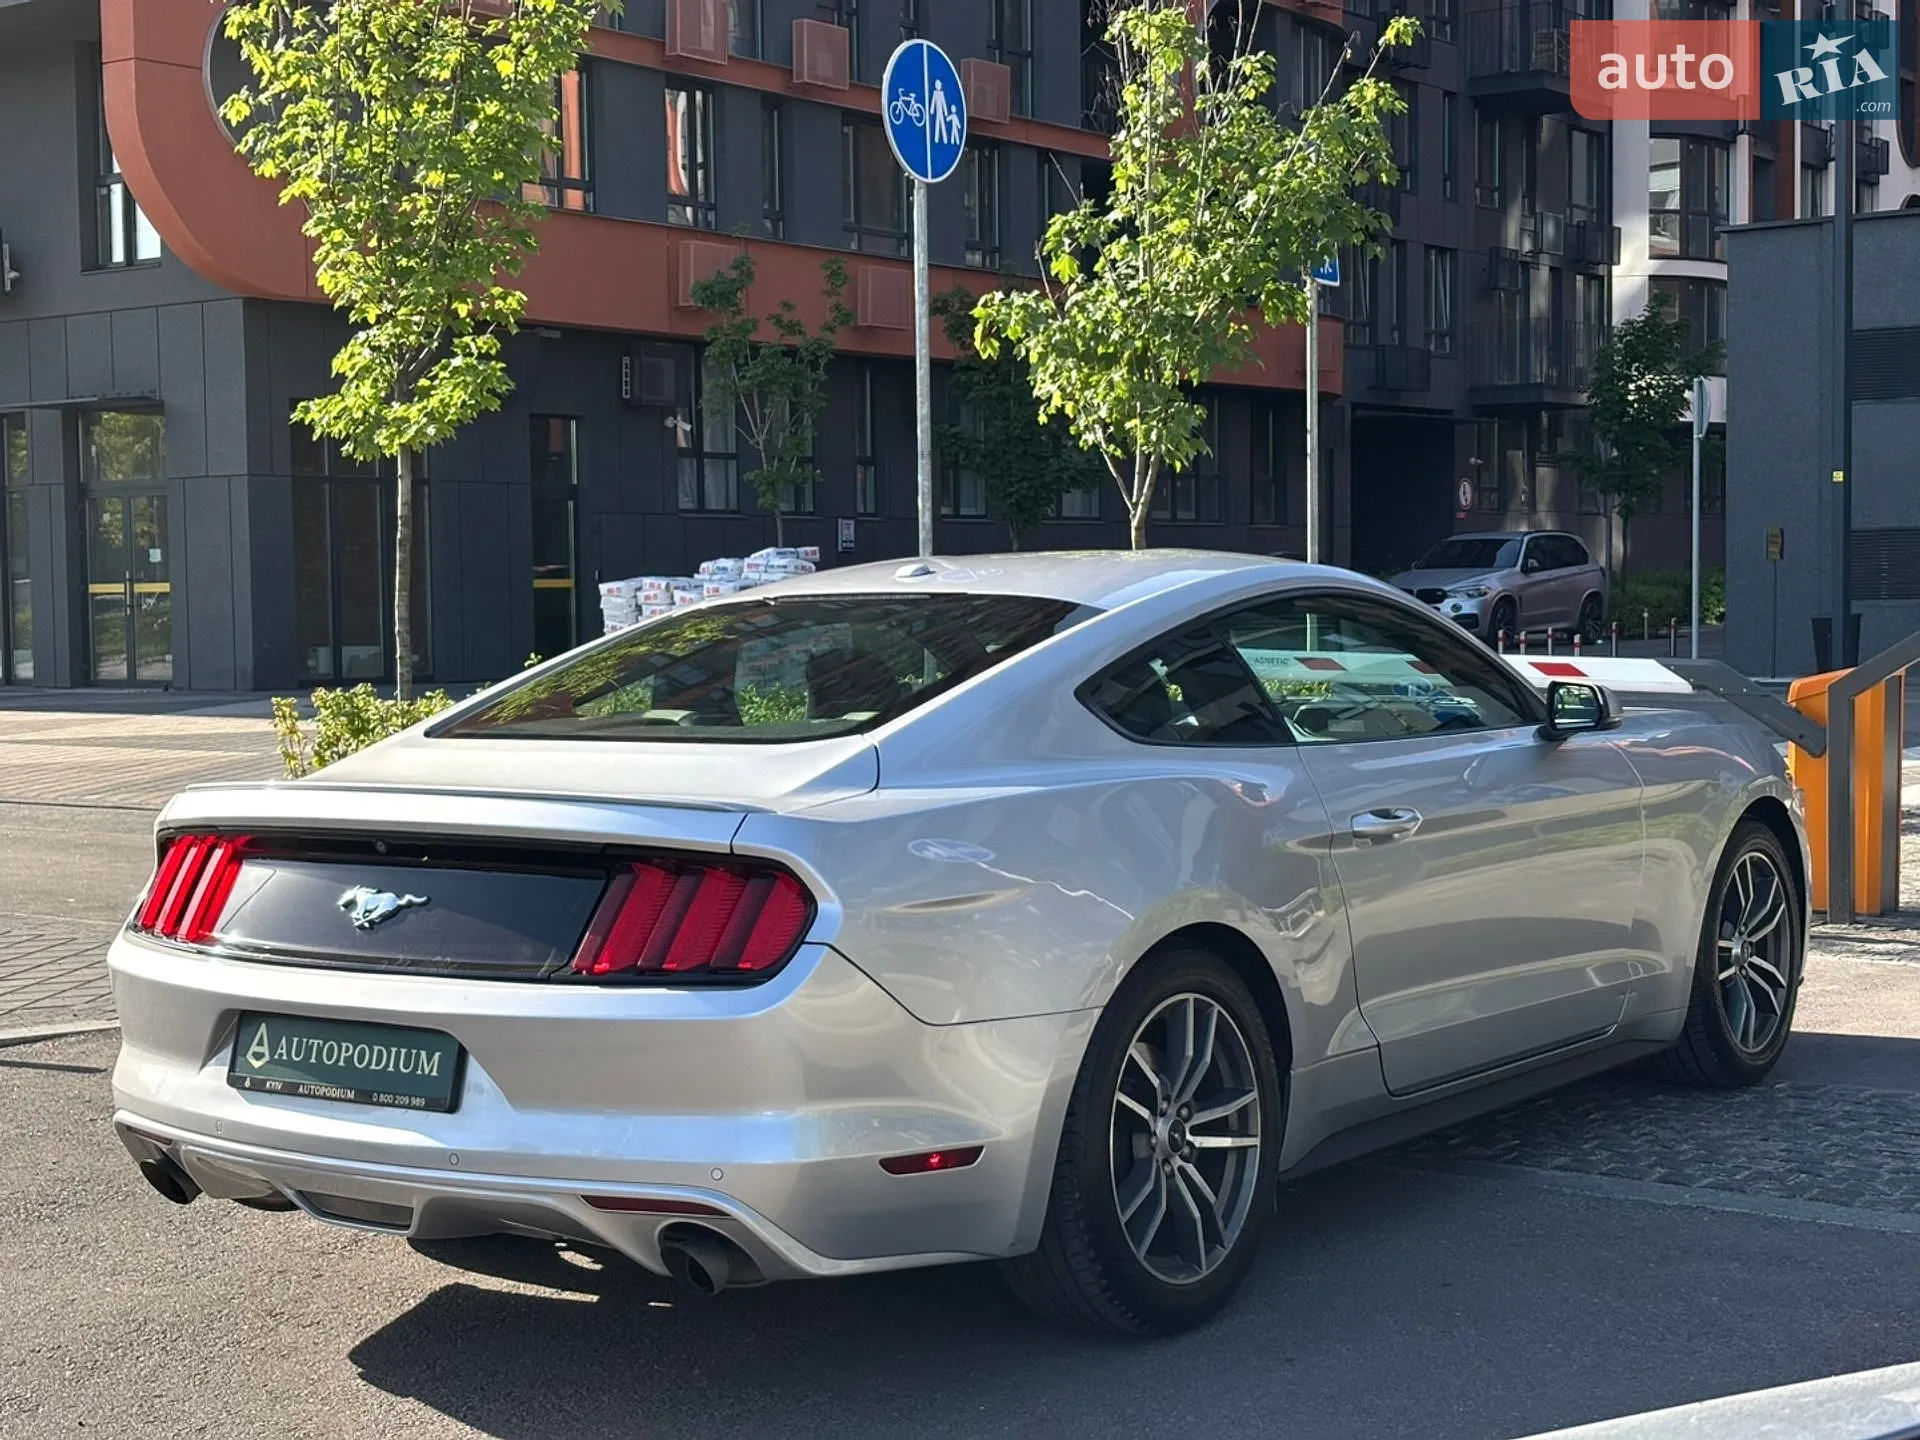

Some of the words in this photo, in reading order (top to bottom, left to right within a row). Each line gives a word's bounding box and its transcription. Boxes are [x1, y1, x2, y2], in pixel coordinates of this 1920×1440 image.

[274, 1036, 441, 1077] AUTOPODIUM
[265, 1080, 283, 1091] KYIV
[298, 1084, 355, 1100] AUTOPODIUM
[372, 1092, 378, 1102] 0
[379, 1093, 394, 1104] 800
[394, 1095, 409, 1105] 209
